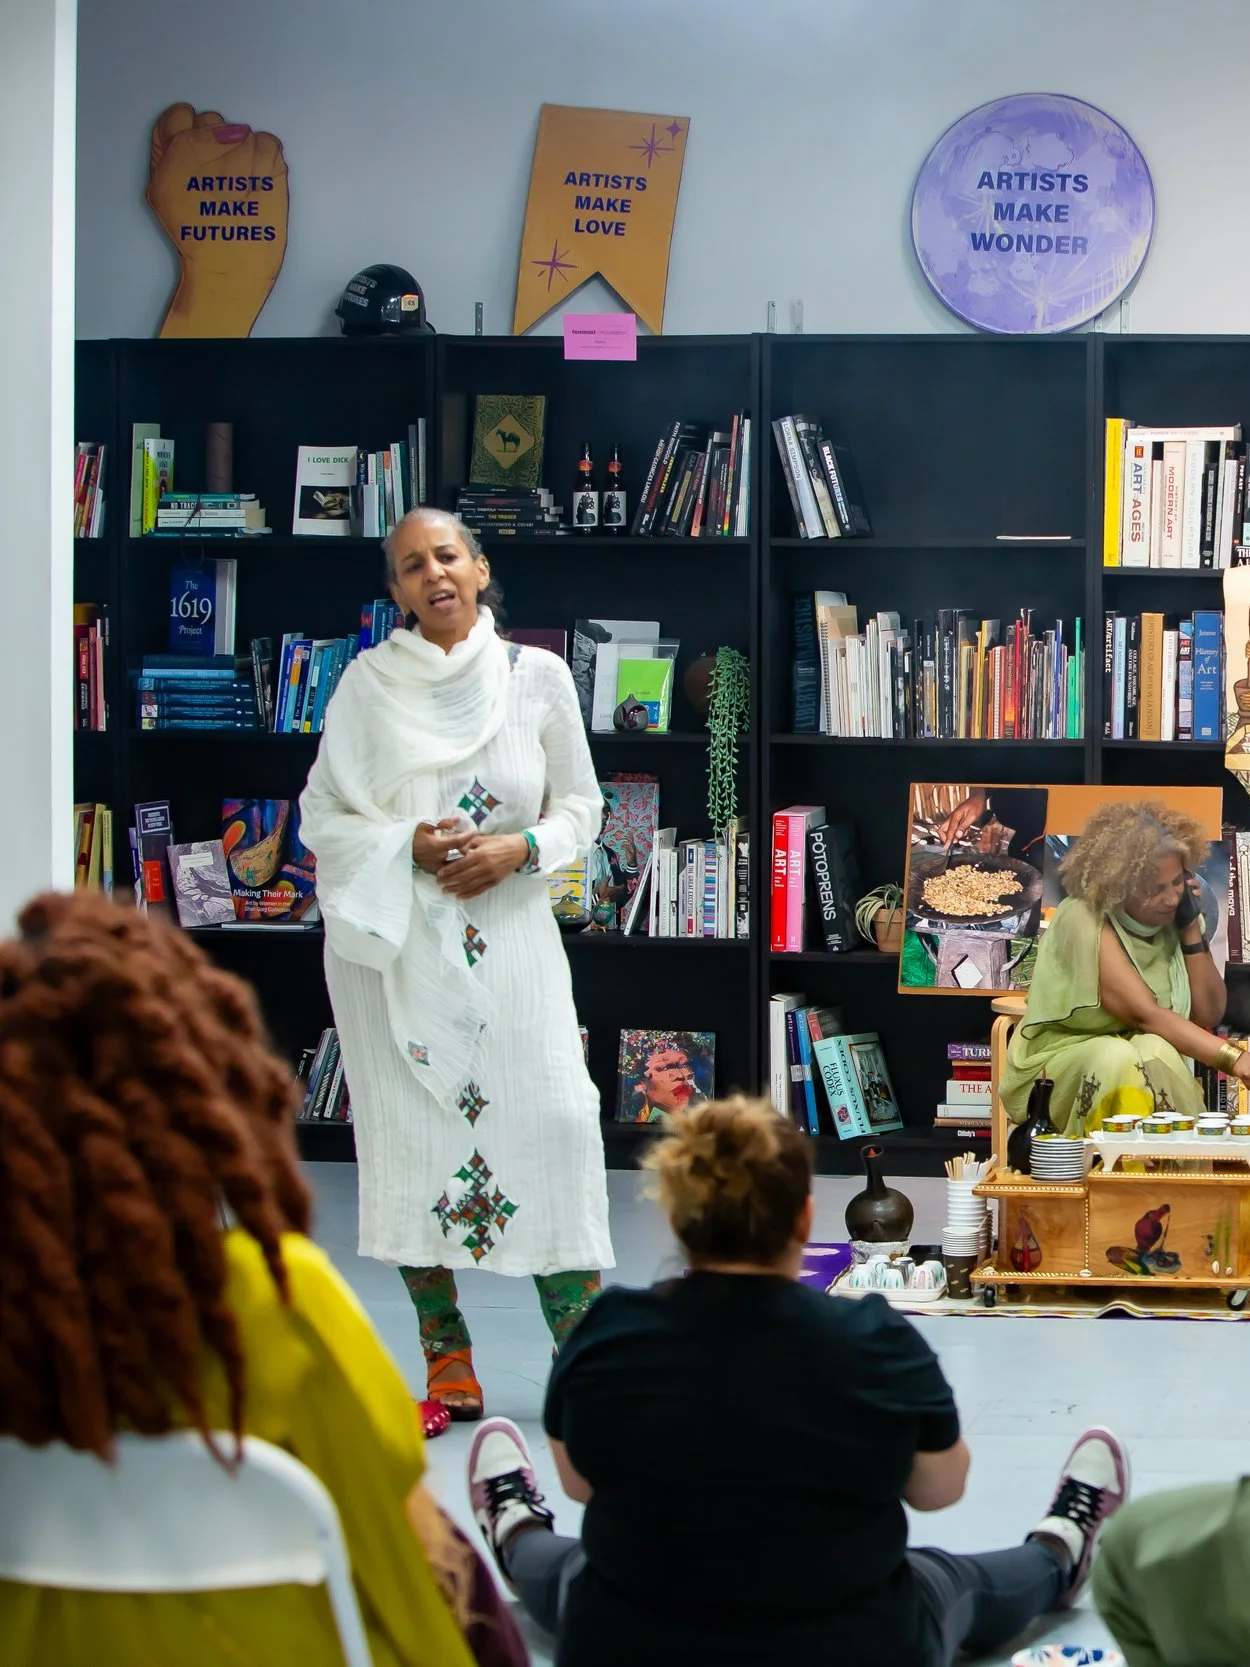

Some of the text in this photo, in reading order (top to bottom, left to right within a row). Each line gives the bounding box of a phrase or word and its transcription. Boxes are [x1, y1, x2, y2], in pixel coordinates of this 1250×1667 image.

[186, 176, 274, 191] ARTISTS
[563, 171, 648, 191] ARTISTS
[976, 171, 1089, 193] ARTISTS
[199, 201, 259, 216] MAKE
[574, 195, 632, 213] MAKE
[993, 203, 1069, 223] MAKE
[180, 226, 276, 241] FUTURES
[574, 219, 627, 236] LOVE
[970, 232, 1088, 255] WONDER
[782, 423, 802, 479] LORNA SIMPSON
[822, 446, 843, 502] BLACK FUTURES
[1167, 466, 1175, 516] MODERN
[1131, 462, 1143, 542] ART AGES
[185, 580, 198, 590] The
[170, 591, 213, 625] 1619
[178, 625, 203, 636] Project
[1105, 618, 1113, 673] ART/artifact
[1180, 647, 1190, 655] ART
[1195, 648, 1218, 658] History
[1196, 664, 1217, 675] Art
[796, 681, 816, 728] LIBERTY
[775, 849, 787, 876] ART
[789, 850, 801, 876] ART
[810, 832, 836, 920] PÒTOPRENS
[233, 889, 304, 899] Making Their Mark
[823, 1065, 837, 1097] CODEX
[829, 1062, 844, 1096] FLUXUS
[960, 1084, 983, 1093] THE
